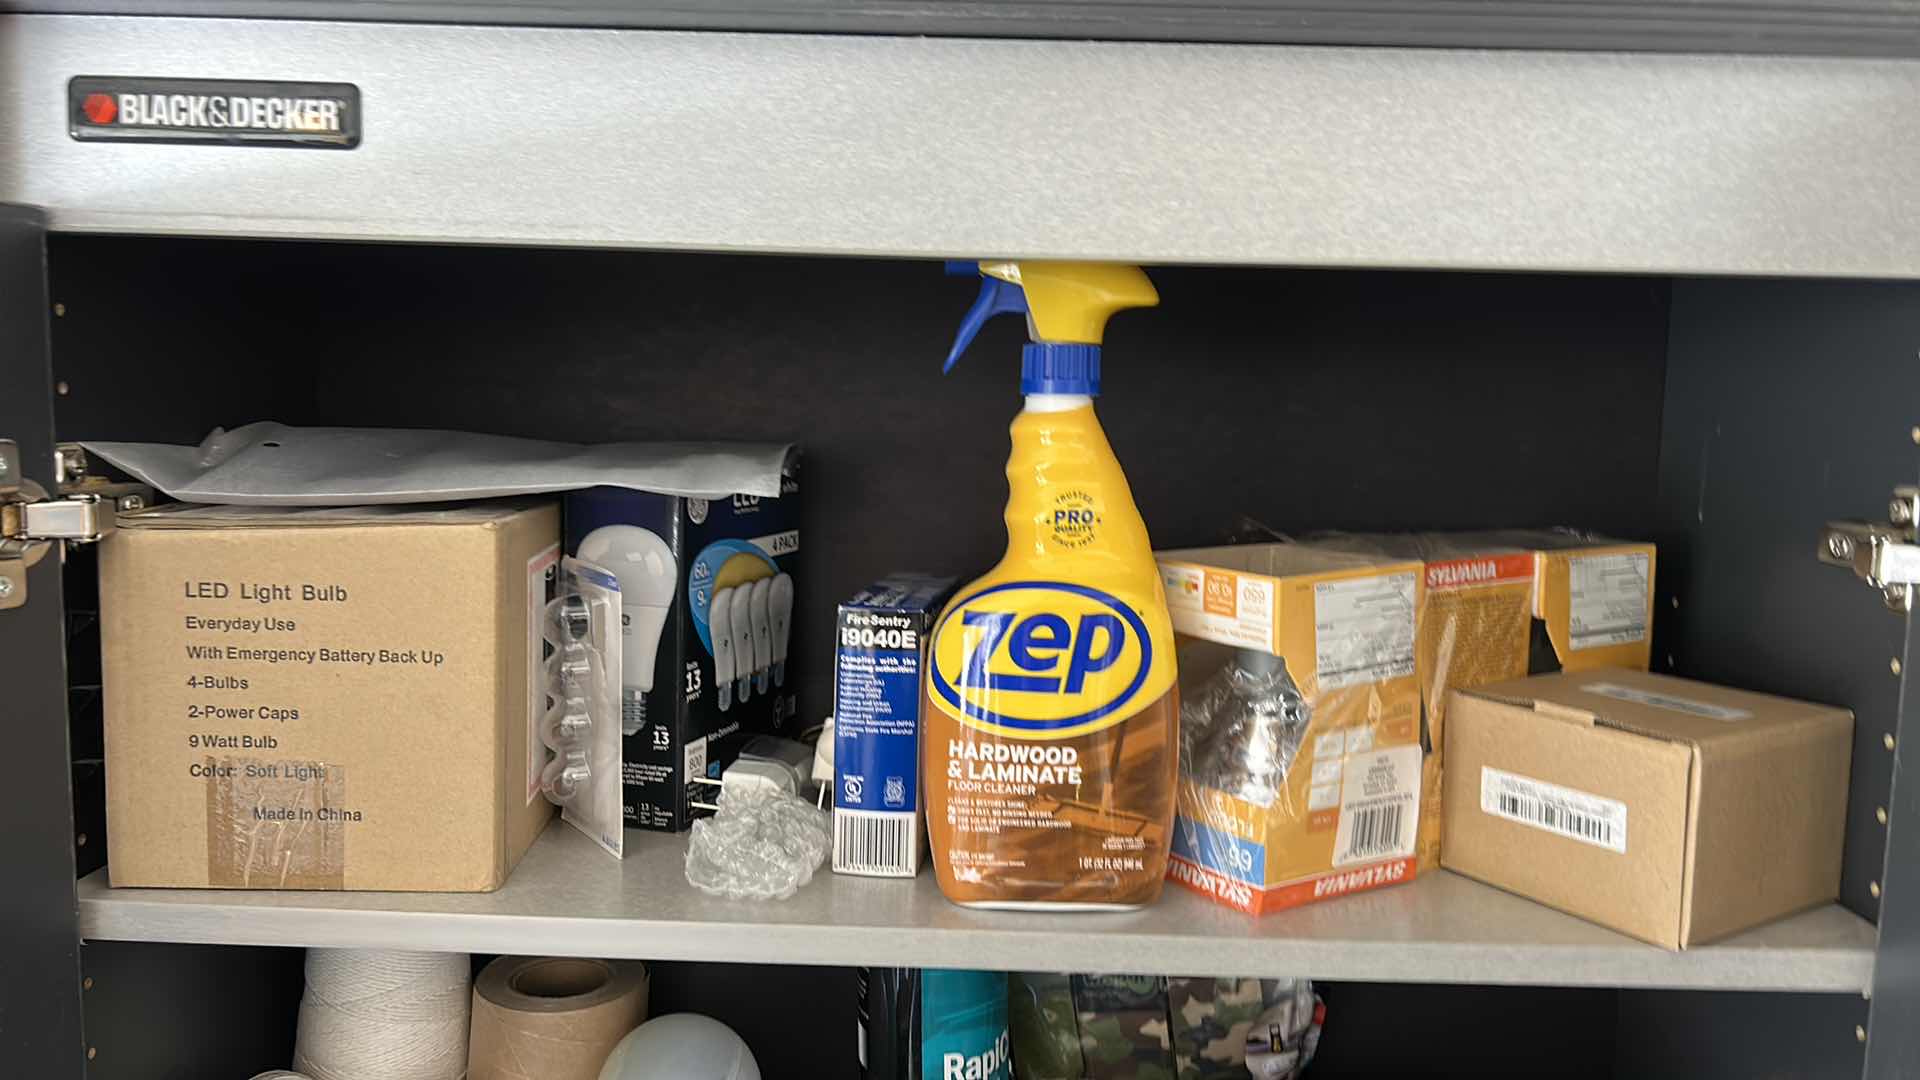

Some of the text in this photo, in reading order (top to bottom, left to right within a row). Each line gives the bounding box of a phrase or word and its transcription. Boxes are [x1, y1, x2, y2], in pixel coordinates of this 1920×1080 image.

[1054, 510, 1094, 526] PRO
[1427, 562, 1497, 586] SYLVANIA
[184, 582, 348, 604] LED Light Bulb
[186, 616, 296, 632] Everyday Use
[841, 627, 917, 648] i9040E
[186, 646, 444, 666] With Emergency Battery Back Up
[879, 656, 899, 666] with
[902, 656, 917, 666] the
[187, 676, 249, 690] 4-Bulbs
[686, 668, 702, 693] 13
[188, 705, 299, 722] 2-Power Caps
[189, 735, 279, 749] 9 Watt Bulb
[653, 731, 670, 745] 13
[948, 739, 1078, 766] HARDWOOD
[190, 763, 325, 782] Color: Soft Light
[947, 759, 1083, 785] & LAMINATE
[947, 780, 1037, 796] FLOOR CLEANER
[253, 807, 362, 822] Made In China
[1313, 860, 1407, 897] SYLVANIA
